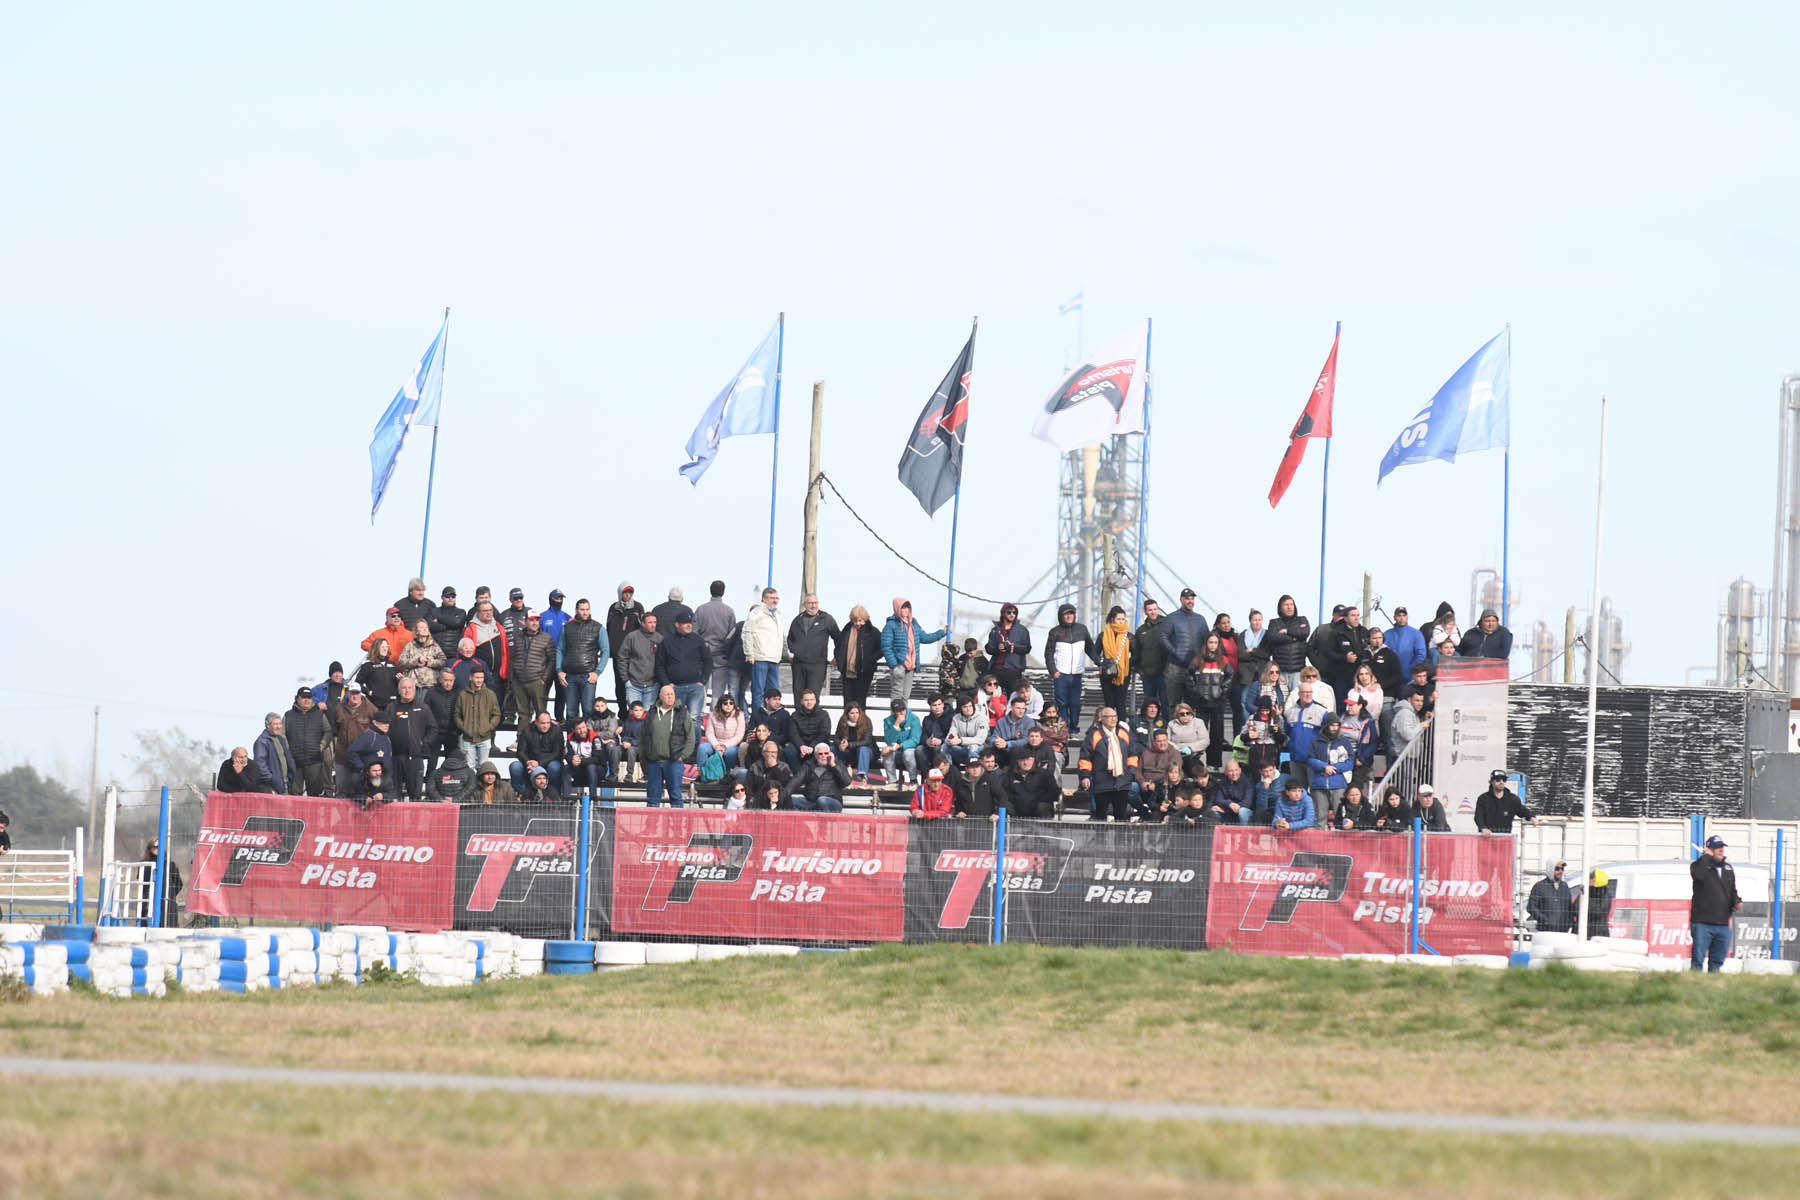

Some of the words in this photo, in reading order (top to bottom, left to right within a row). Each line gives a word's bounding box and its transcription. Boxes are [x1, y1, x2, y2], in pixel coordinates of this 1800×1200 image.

[199, 829, 268, 846] Turismo
[471, 837, 556, 854] Turismo
[235, 847, 280, 862] Pista
[313, 835, 434, 863] Turismo
[645, 847, 715, 862] Turismo
[515, 856, 572, 873] Pista
[761, 850, 882, 875] Turismo
[300, 861, 377, 889] Pista
[681, 864, 728, 879] Pista
[1094, 863, 1196, 883] Turismo
[1244, 866, 1317, 883] Turismo
[749, 878, 826, 902] Pista
[1084, 885, 1153, 904] Pista
[1281, 883, 1330, 899] Pista
[1352, 899, 1434, 924] Pista
